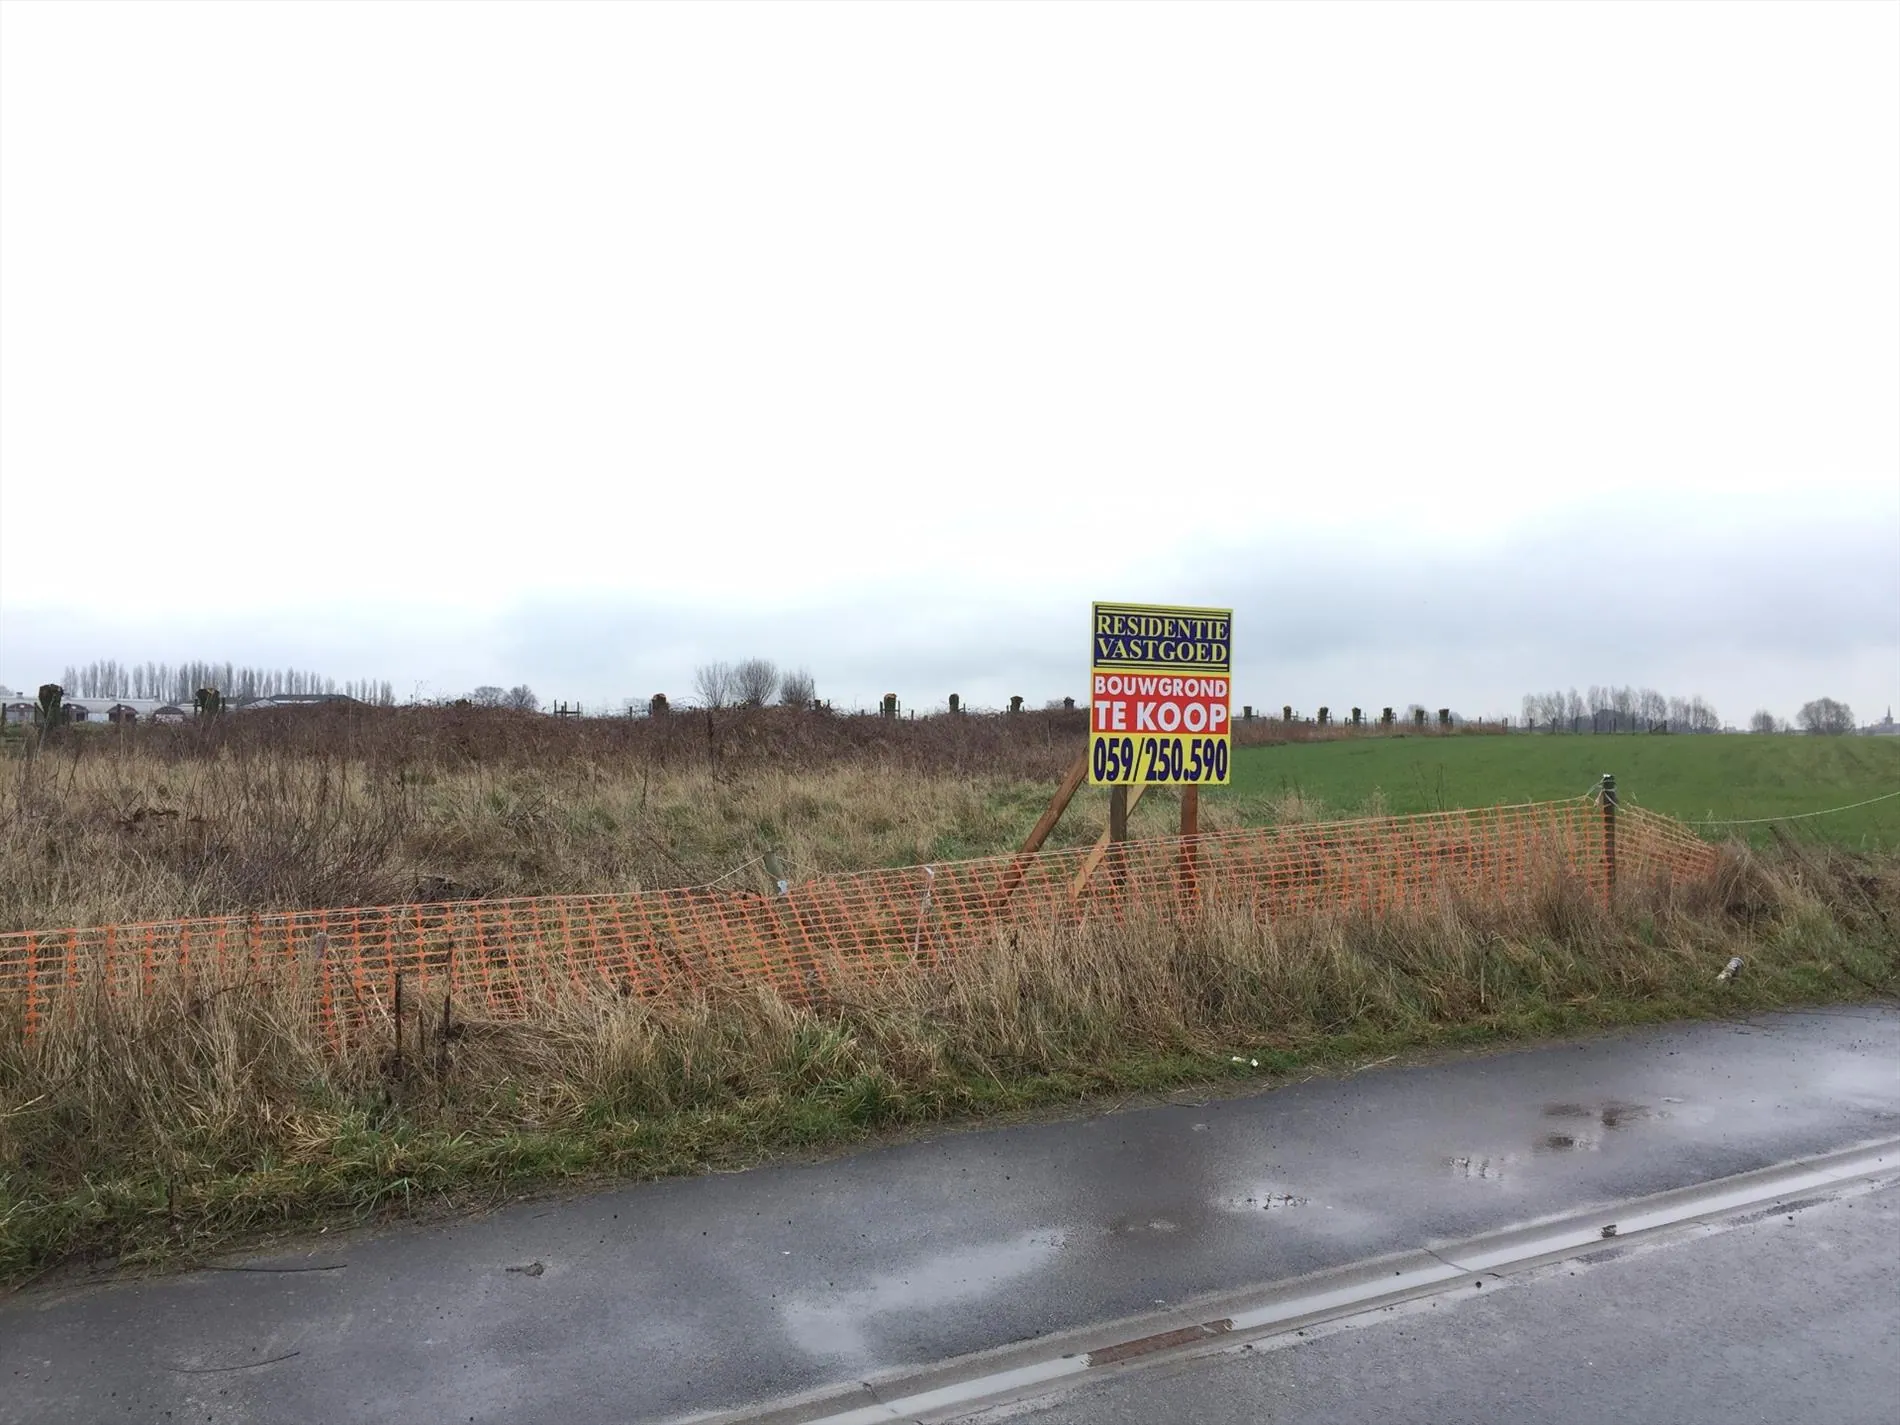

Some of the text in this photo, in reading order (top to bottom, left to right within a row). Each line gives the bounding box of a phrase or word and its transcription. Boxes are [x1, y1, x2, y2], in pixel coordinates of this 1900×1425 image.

[1096, 615, 1229, 640] RESIDENTIE
[1097, 638, 1227, 662] VASTGOED
[1095, 676, 1227, 697] BOUWGROND
[1095, 700, 1226, 732] TE KOOP
[1094, 737, 1227, 782] 059/250.590
